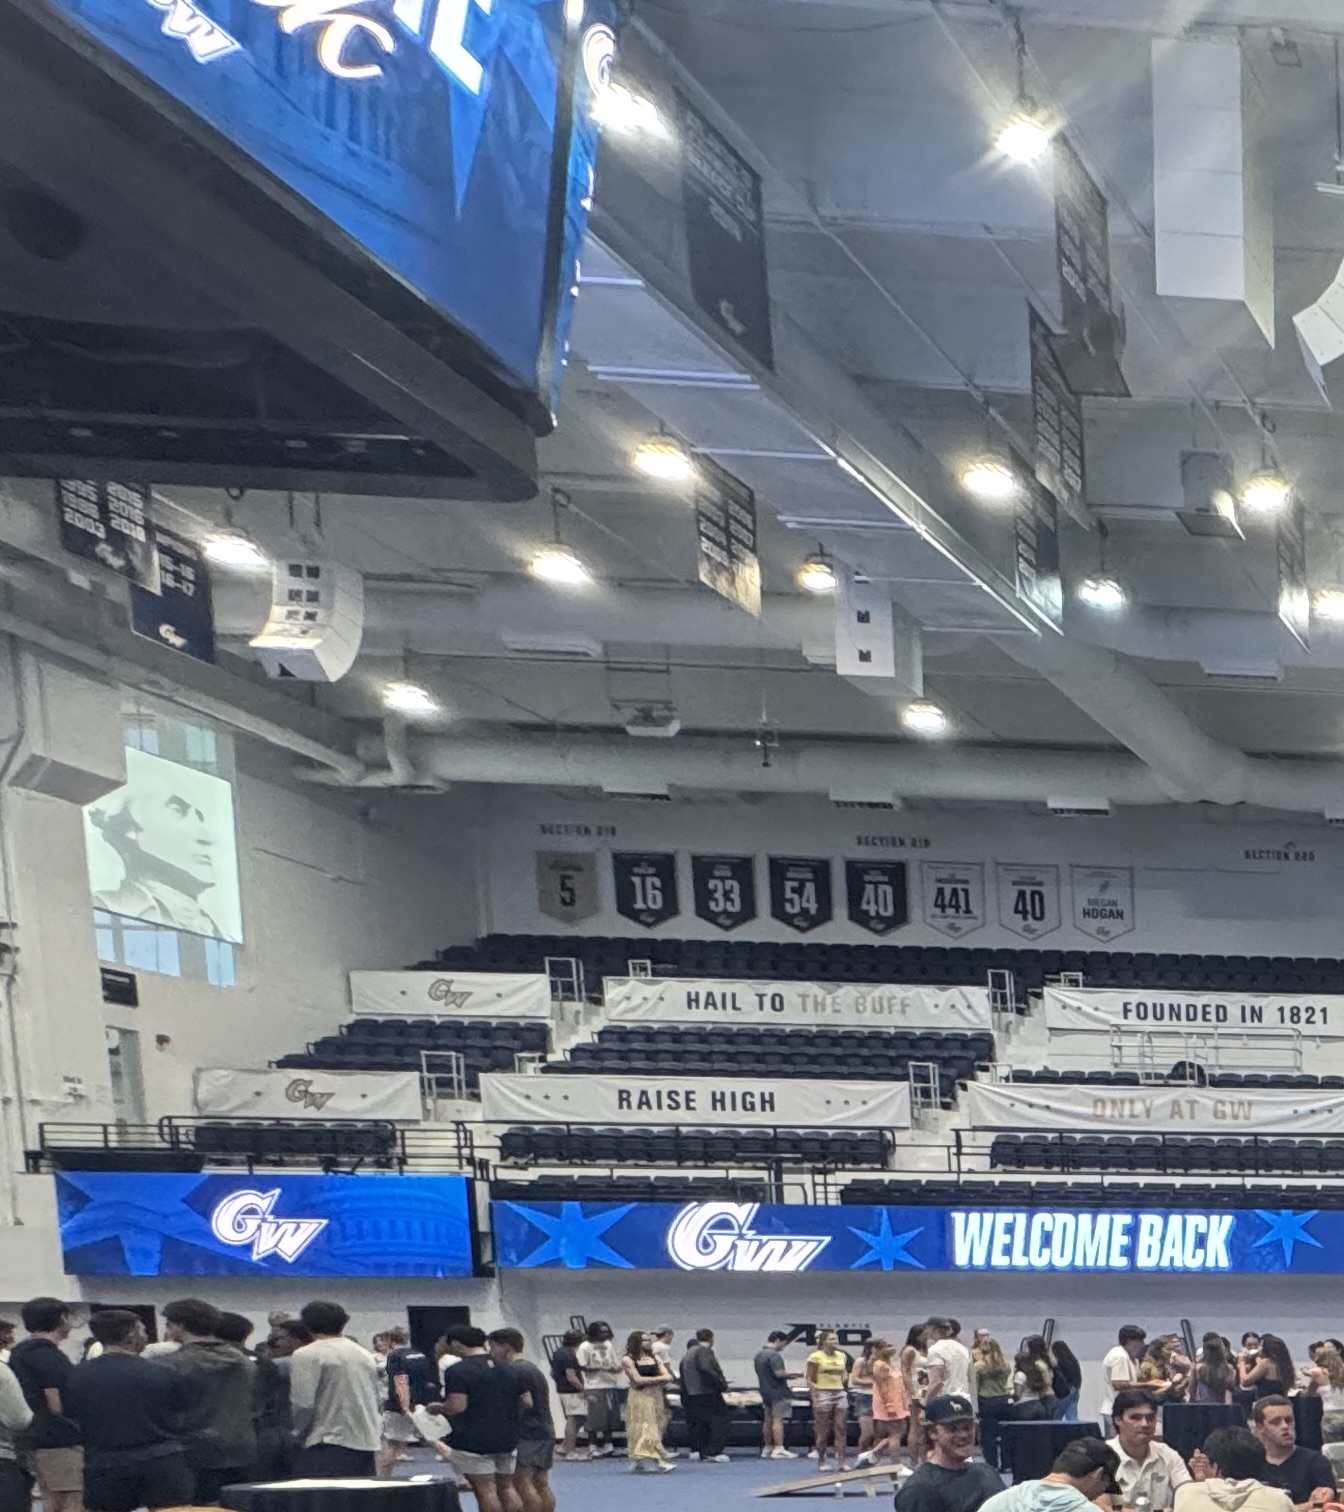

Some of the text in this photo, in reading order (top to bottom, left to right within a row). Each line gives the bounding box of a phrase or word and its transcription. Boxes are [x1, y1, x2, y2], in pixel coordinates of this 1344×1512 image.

[856, 835, 906, 848] SECTION
[559, 874, 577, 907] 5
[630, 875, 664, 910] 16
[706, 878, 742, 914] 33
[783, 880, 819, 916] 54
[860, 883, 895, 918] 40
[933, 886, 974, 916] 441
[1013, 888, 1046, 923] 40
[1082, 907, 1124, 921] HOGAN
[686, 990, 912, 1016] HAIL TO THE BUFF
[1122, 1001, 1329, 1026] FOUNDED IN 1821
[617, 1087, 776, 1113] RAISE HIGH
[1091, 1097, 1254, 1121] ONLY AT GW
[210, 1186, 329, 1264] GW
[949, 1211, 1132, 1270] WELCOME
[1135, 1213, 1236, 1270] BACK
